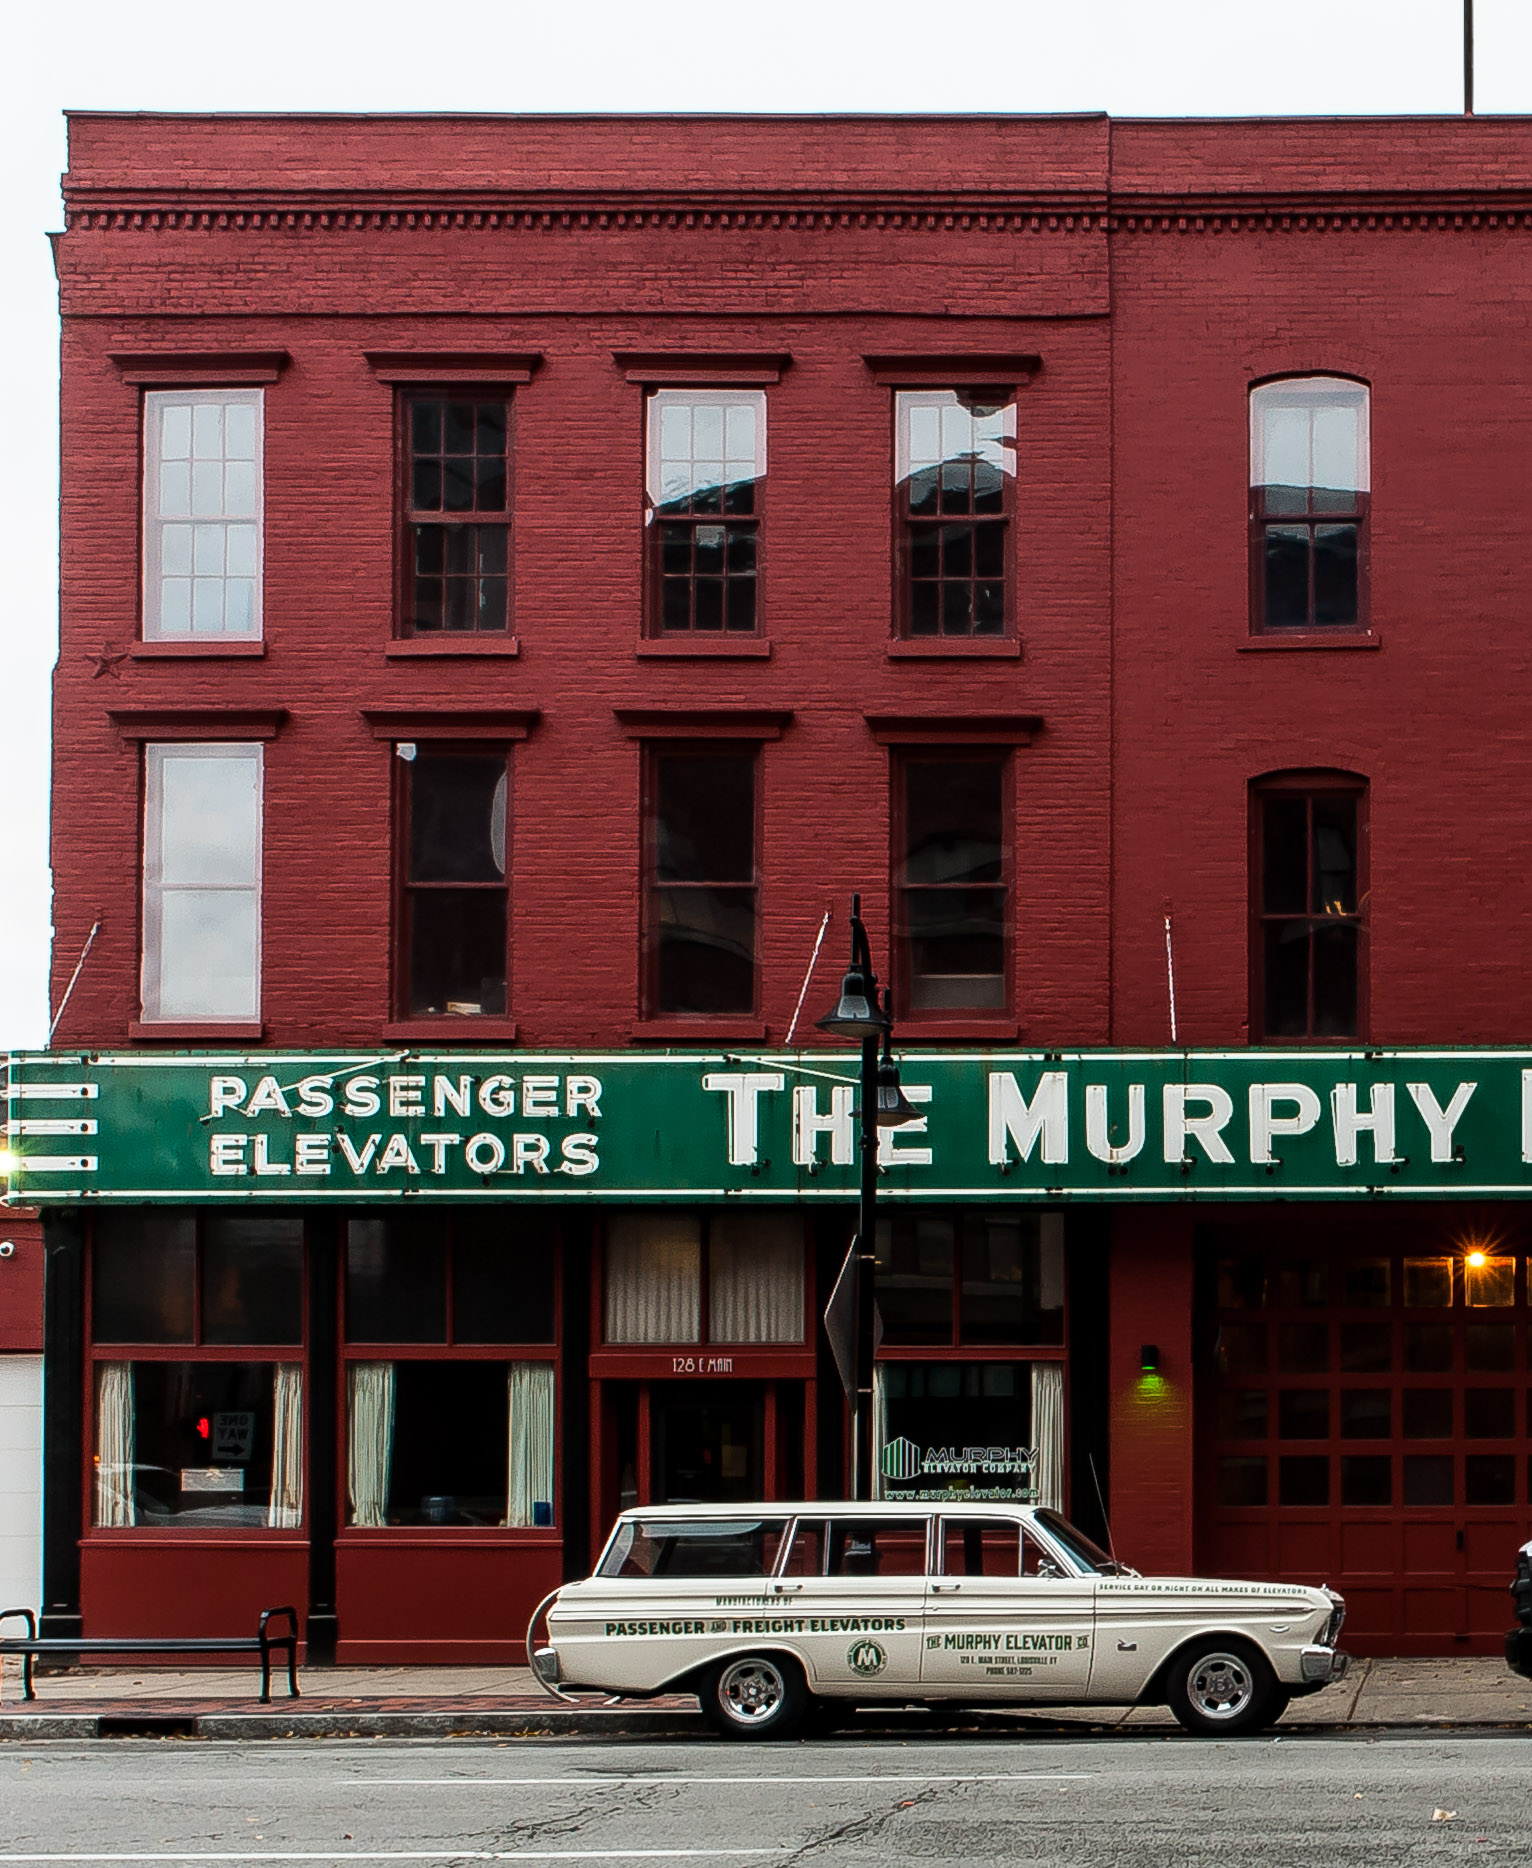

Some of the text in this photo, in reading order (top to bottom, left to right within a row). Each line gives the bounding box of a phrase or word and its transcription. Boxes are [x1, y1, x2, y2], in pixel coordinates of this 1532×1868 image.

[211, 1075, 602, 1118] PASSENGER
[703, 1072, 933, 1166] THE
[988, 1071, 1478, 1166] MURPHY
[210, 1132, 600, 1176] ELEVATORS
[672, 1358, 733, 1373] 128 E MAIN
[926, 1447, 1040, 1462] MURPHY
[923, 1462, 1038, 1473] ELEVATOR COMPANY
[1099, 1583, 1132, 1591] SERVICE
[1263, 1587, 1308, 1595] ELEVATORS
[605, 1618, 906, 1636] PASSENGER AND FREIGHT ELEVATORS
[926, 1636, 942, 1649] THE
[943, 1634, 1001, 1650] MURPHY
[1006, 1634, 1073, 1650] ELEVATOR
[857, 1647, 878, 1666] M
